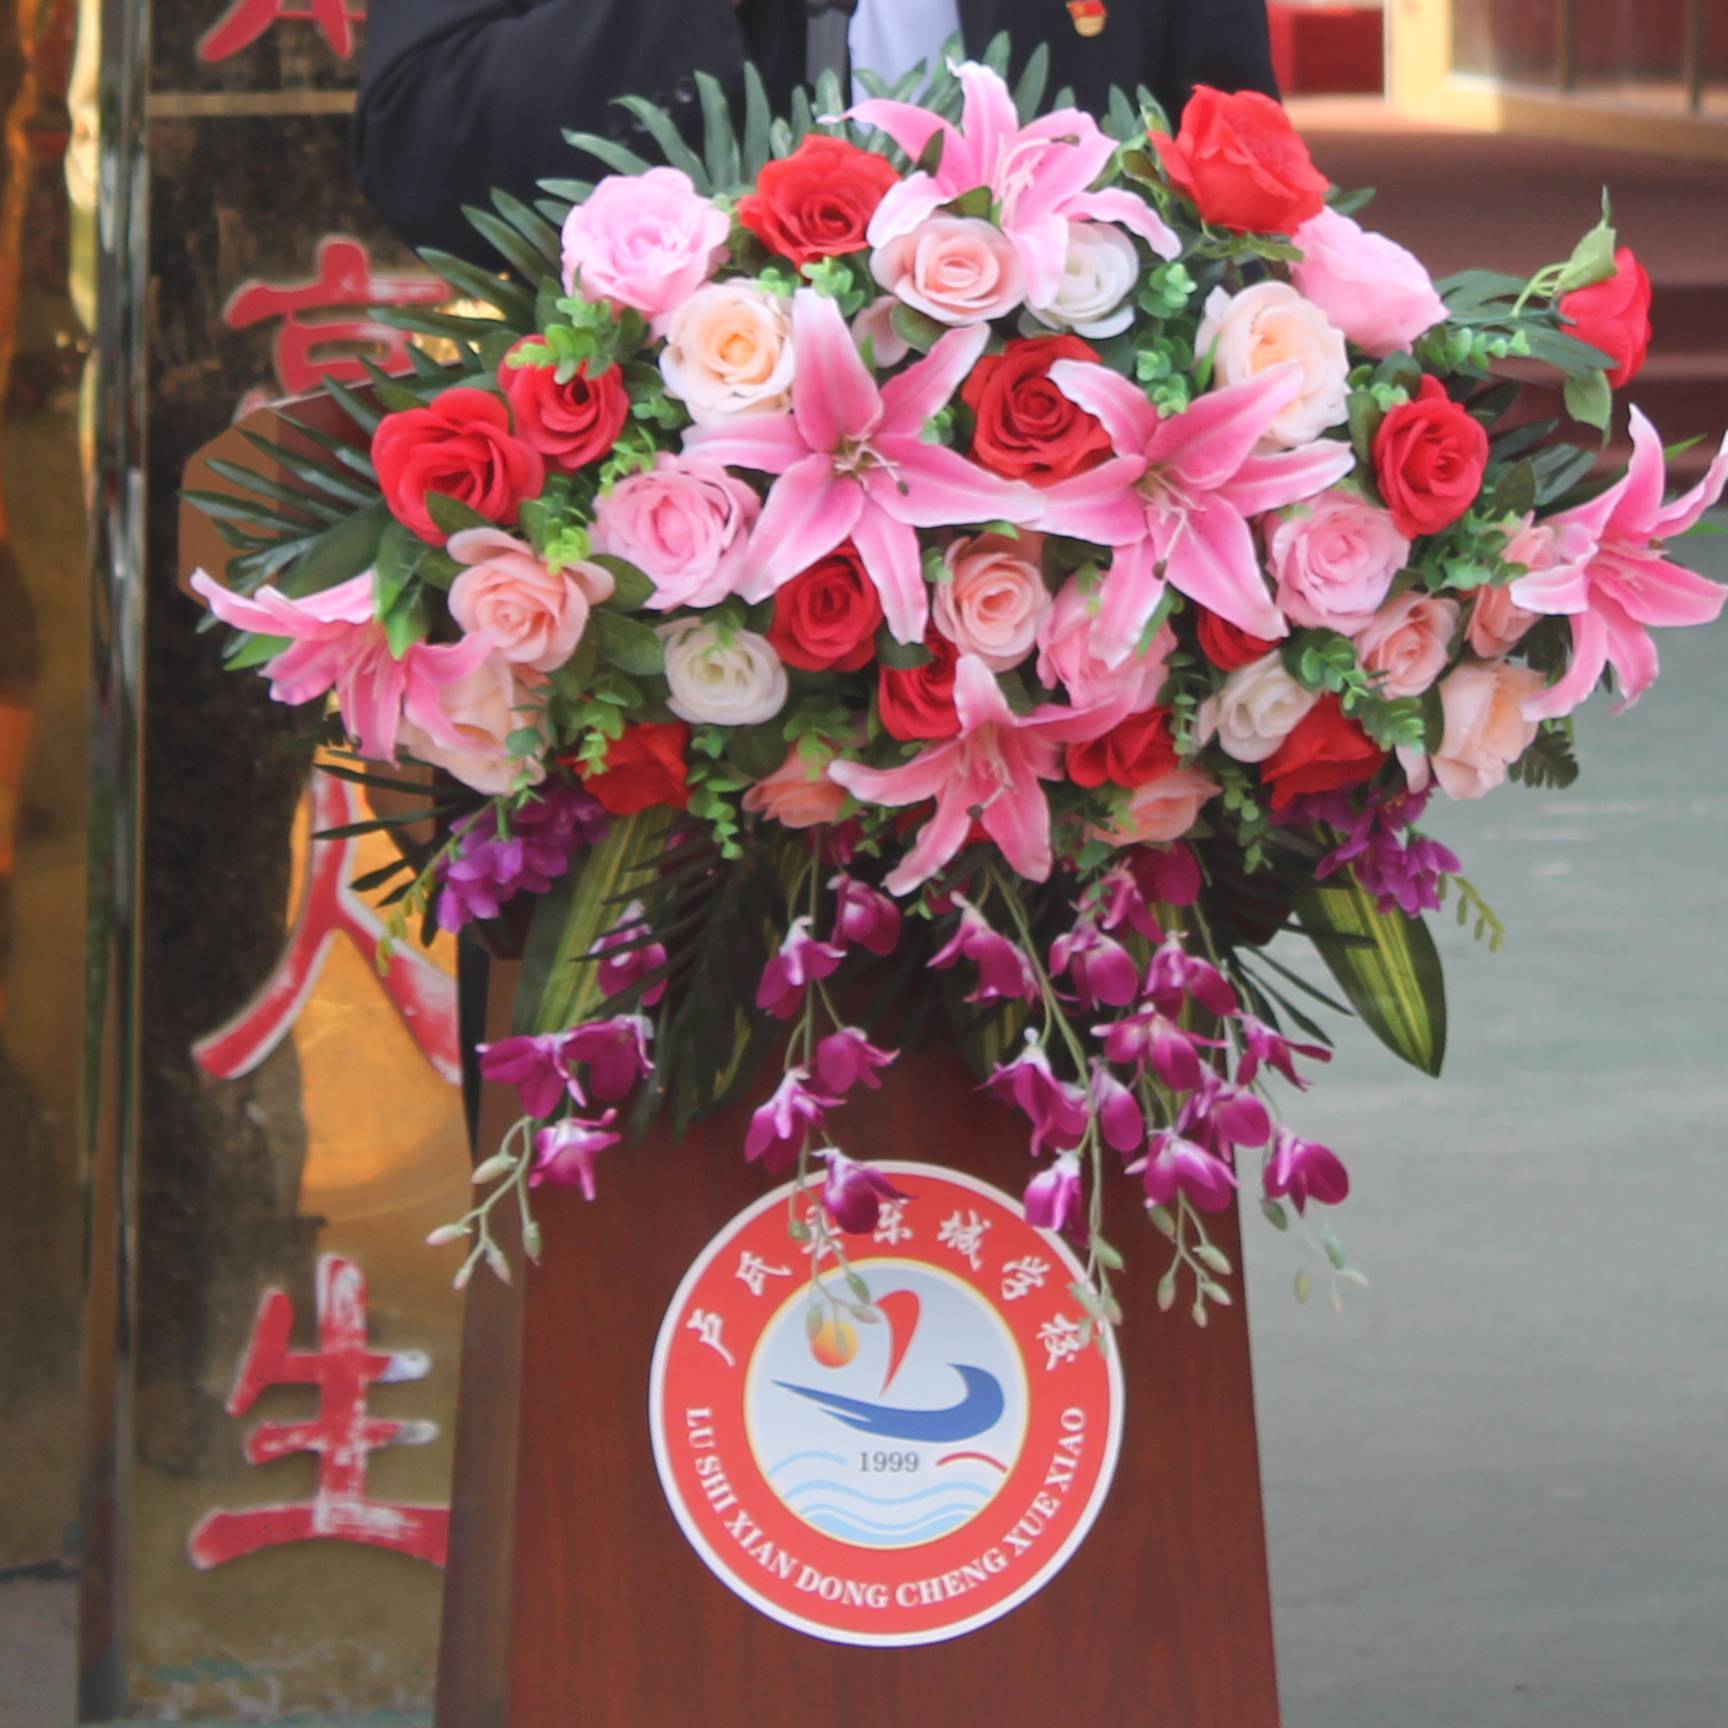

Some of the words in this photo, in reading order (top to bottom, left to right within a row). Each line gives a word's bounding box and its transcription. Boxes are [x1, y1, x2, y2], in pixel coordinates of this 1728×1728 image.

[685, 1407, 716, 1449] LU
[1044, 1407, 1088, 1493] XIAO
[694, 1455, 738, 1514] SHI
[859, 1451, 920, 1473] 1999
[724, 1510, 799, 1580] XIAN
[1002, 1491, 1062, 1558] XUE
[794, 1566, 890, 1609] DONG
[895, 1547, 1010, 1608] CHENG
